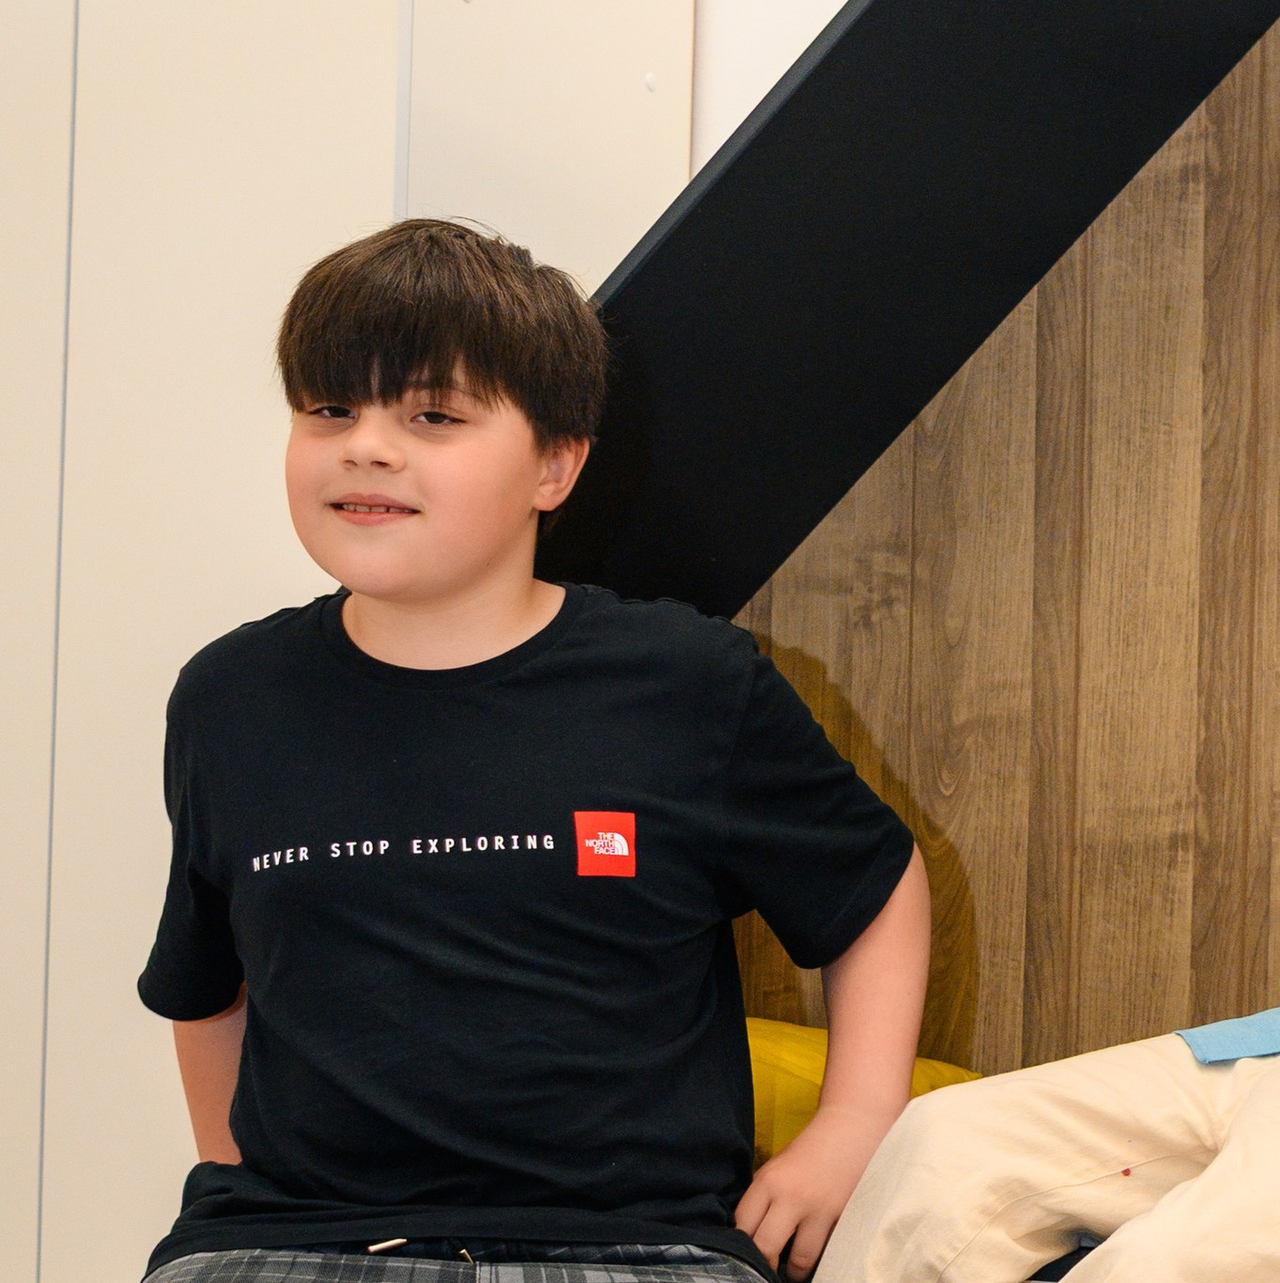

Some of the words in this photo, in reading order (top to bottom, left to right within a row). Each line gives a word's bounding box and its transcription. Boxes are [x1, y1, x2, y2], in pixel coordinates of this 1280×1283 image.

[585, 839, 616, 847] NORTH
[252, 846, 309, 872] NEVER
[330, 840, 389, 858] STOP
[412, 835, 555, 854] EXPLORING
[594, 847, 616, 855] FACE
